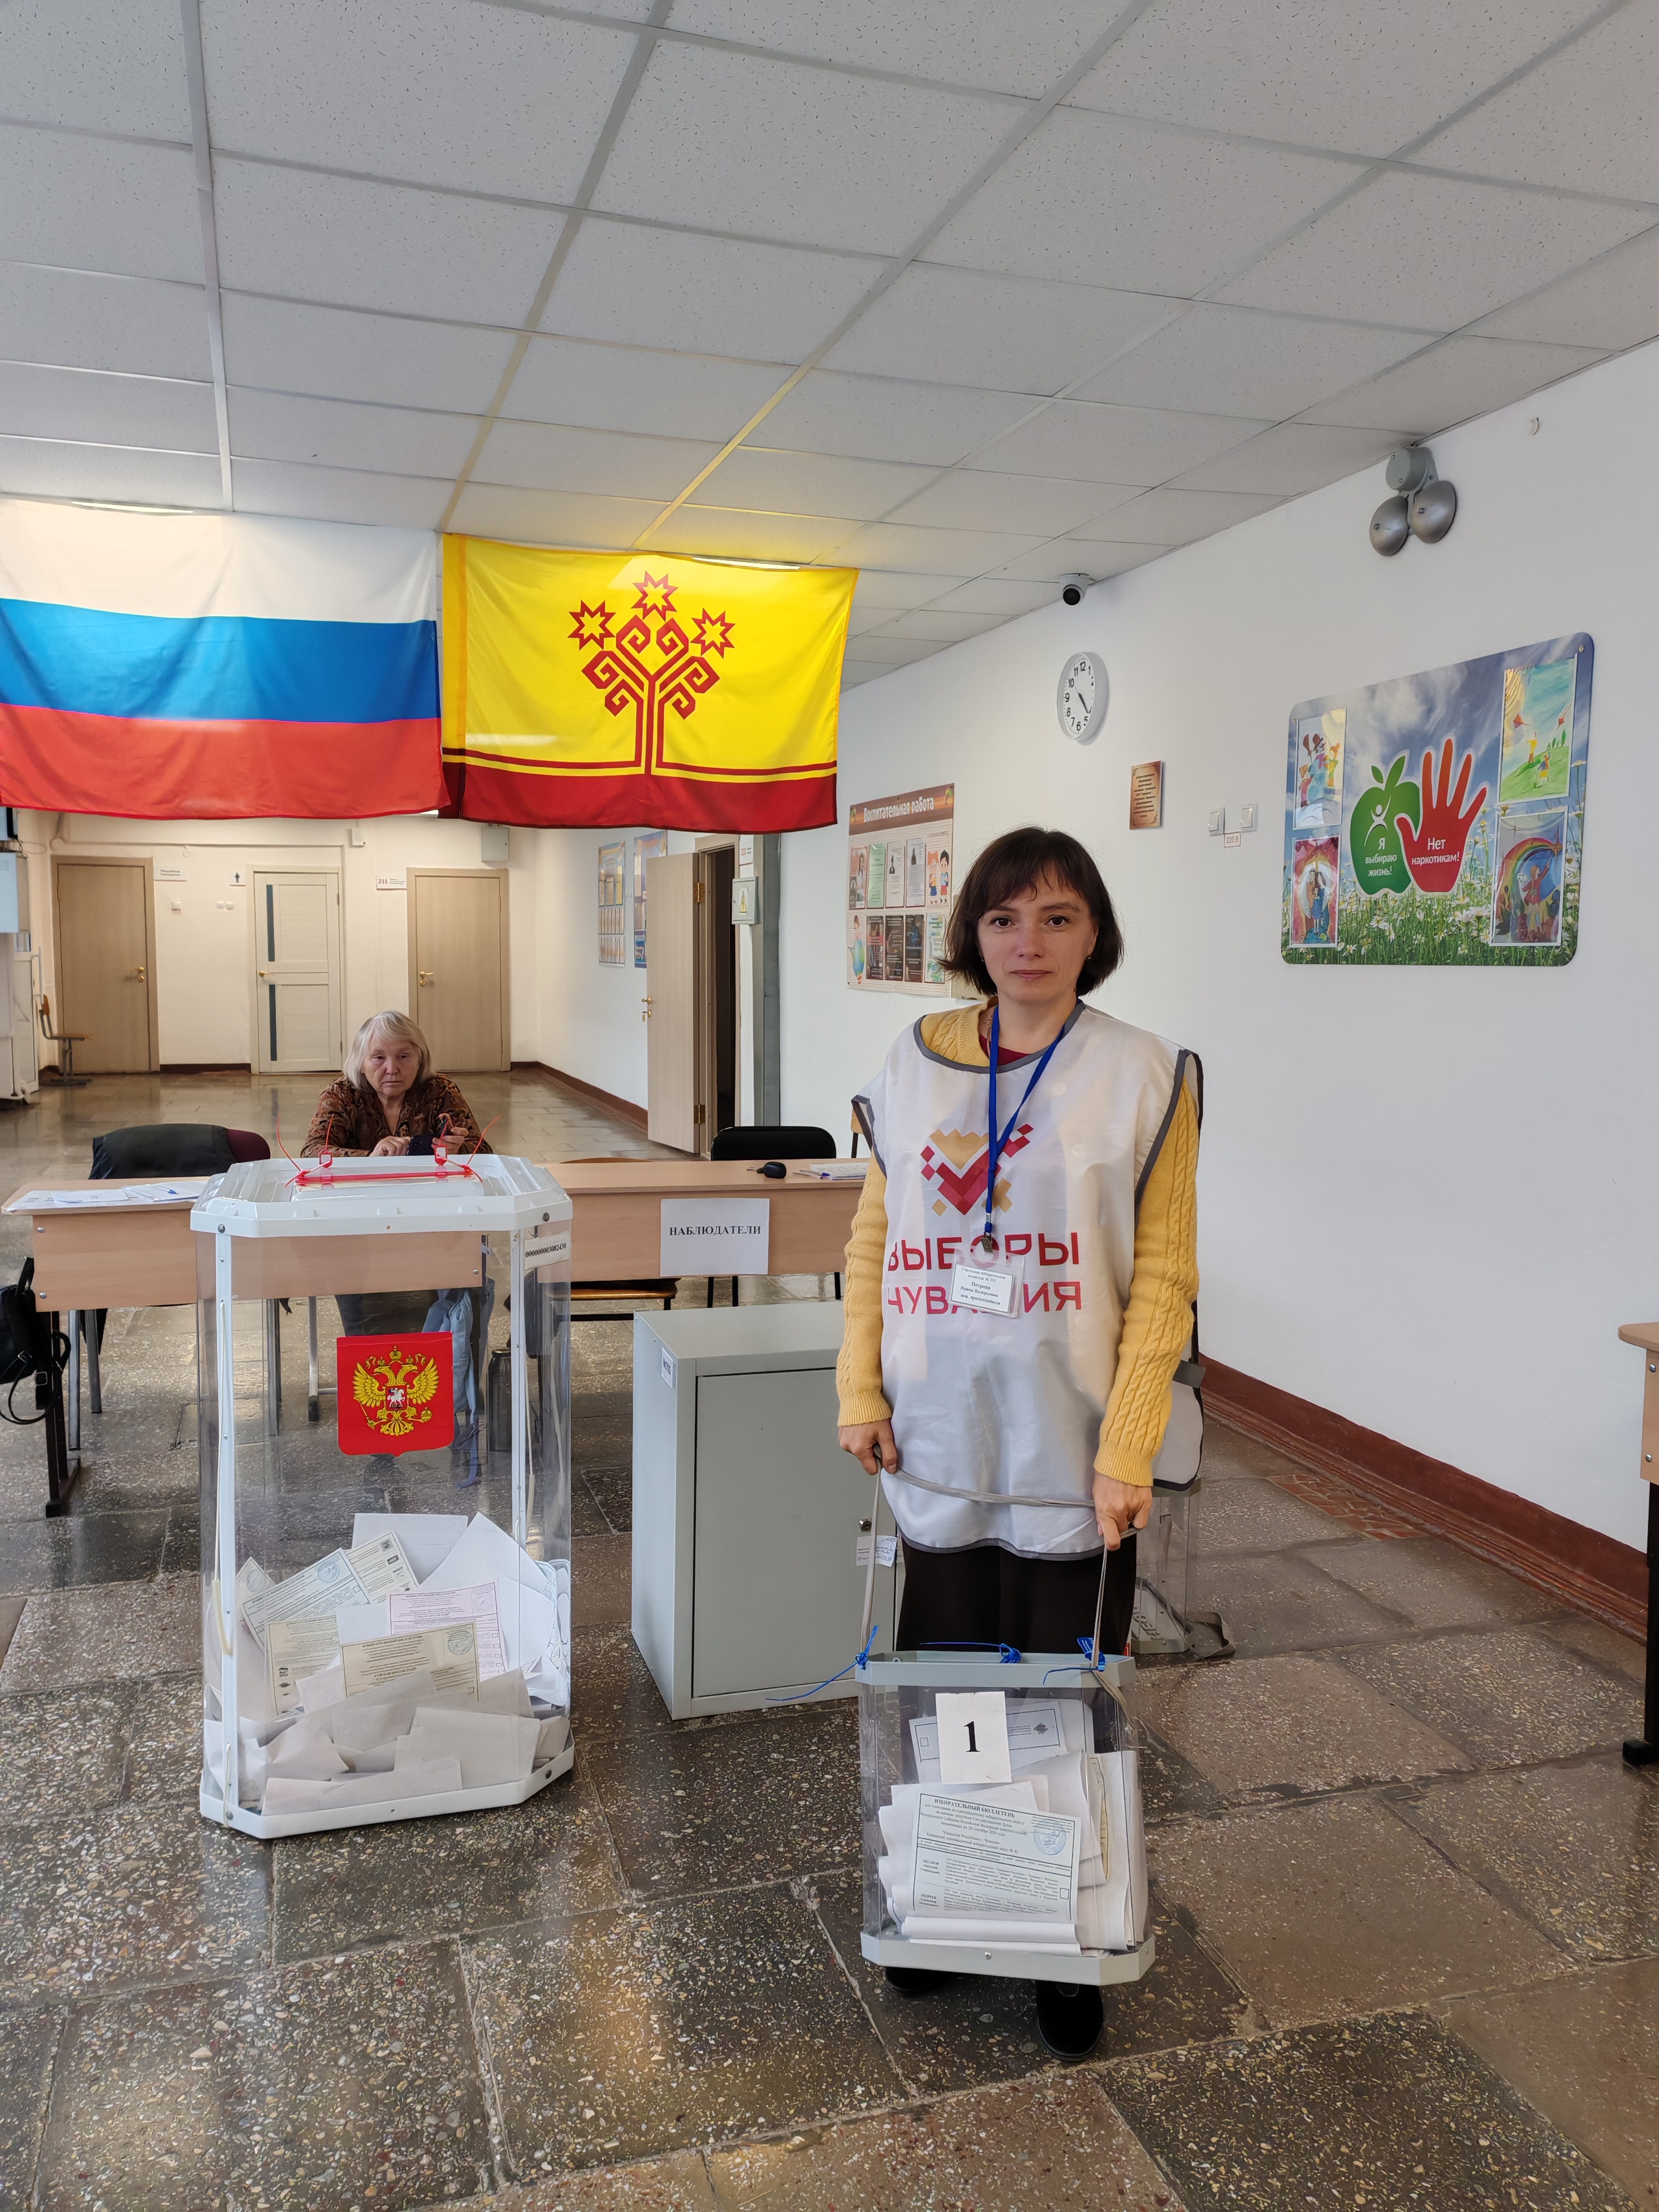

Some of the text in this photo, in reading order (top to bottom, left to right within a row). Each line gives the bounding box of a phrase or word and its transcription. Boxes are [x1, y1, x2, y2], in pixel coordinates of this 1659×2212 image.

[1080, 661, 1086, 671] 12
[1088, 665, 1091, 675] 1
[1074, 667, 1078, 677] 11
[1068, 678, 1074, 688] 10
[1065, 692, 1070, 702] 9
[1067, 707, 1071, 717] 8
[1071, 717, 1075, 727] 7
[1076, 721, 1081, 731] 6
[1083, 716, 1088, 726] 5
[864, 796, 934, 822] Воспитательная работа
[1378, 838, 1385, 850] Я
[1427, 837, 1446, 851] Нет
[1365, 853, 1397, 865] выбираю
[1412, 851, 1459, 866] наркотикам!
[1368, 865, 1392, 876] жизнь!
[670, 1225, 761, 1236] НАБЛЮДАТЕЛИ
[972, 1282, 990, 1290] Петрова
[888, 1281, 1081, 1314] ЧУВИЯ
[975, 1289, 999, 1297] Валерьевна
[963, 1721, 981, 1752] 1
[934, 1798, 1015, 1818] ИЗБИРАТЕЛЬНЫЙ БЮЛЛЕТЕНЬ
